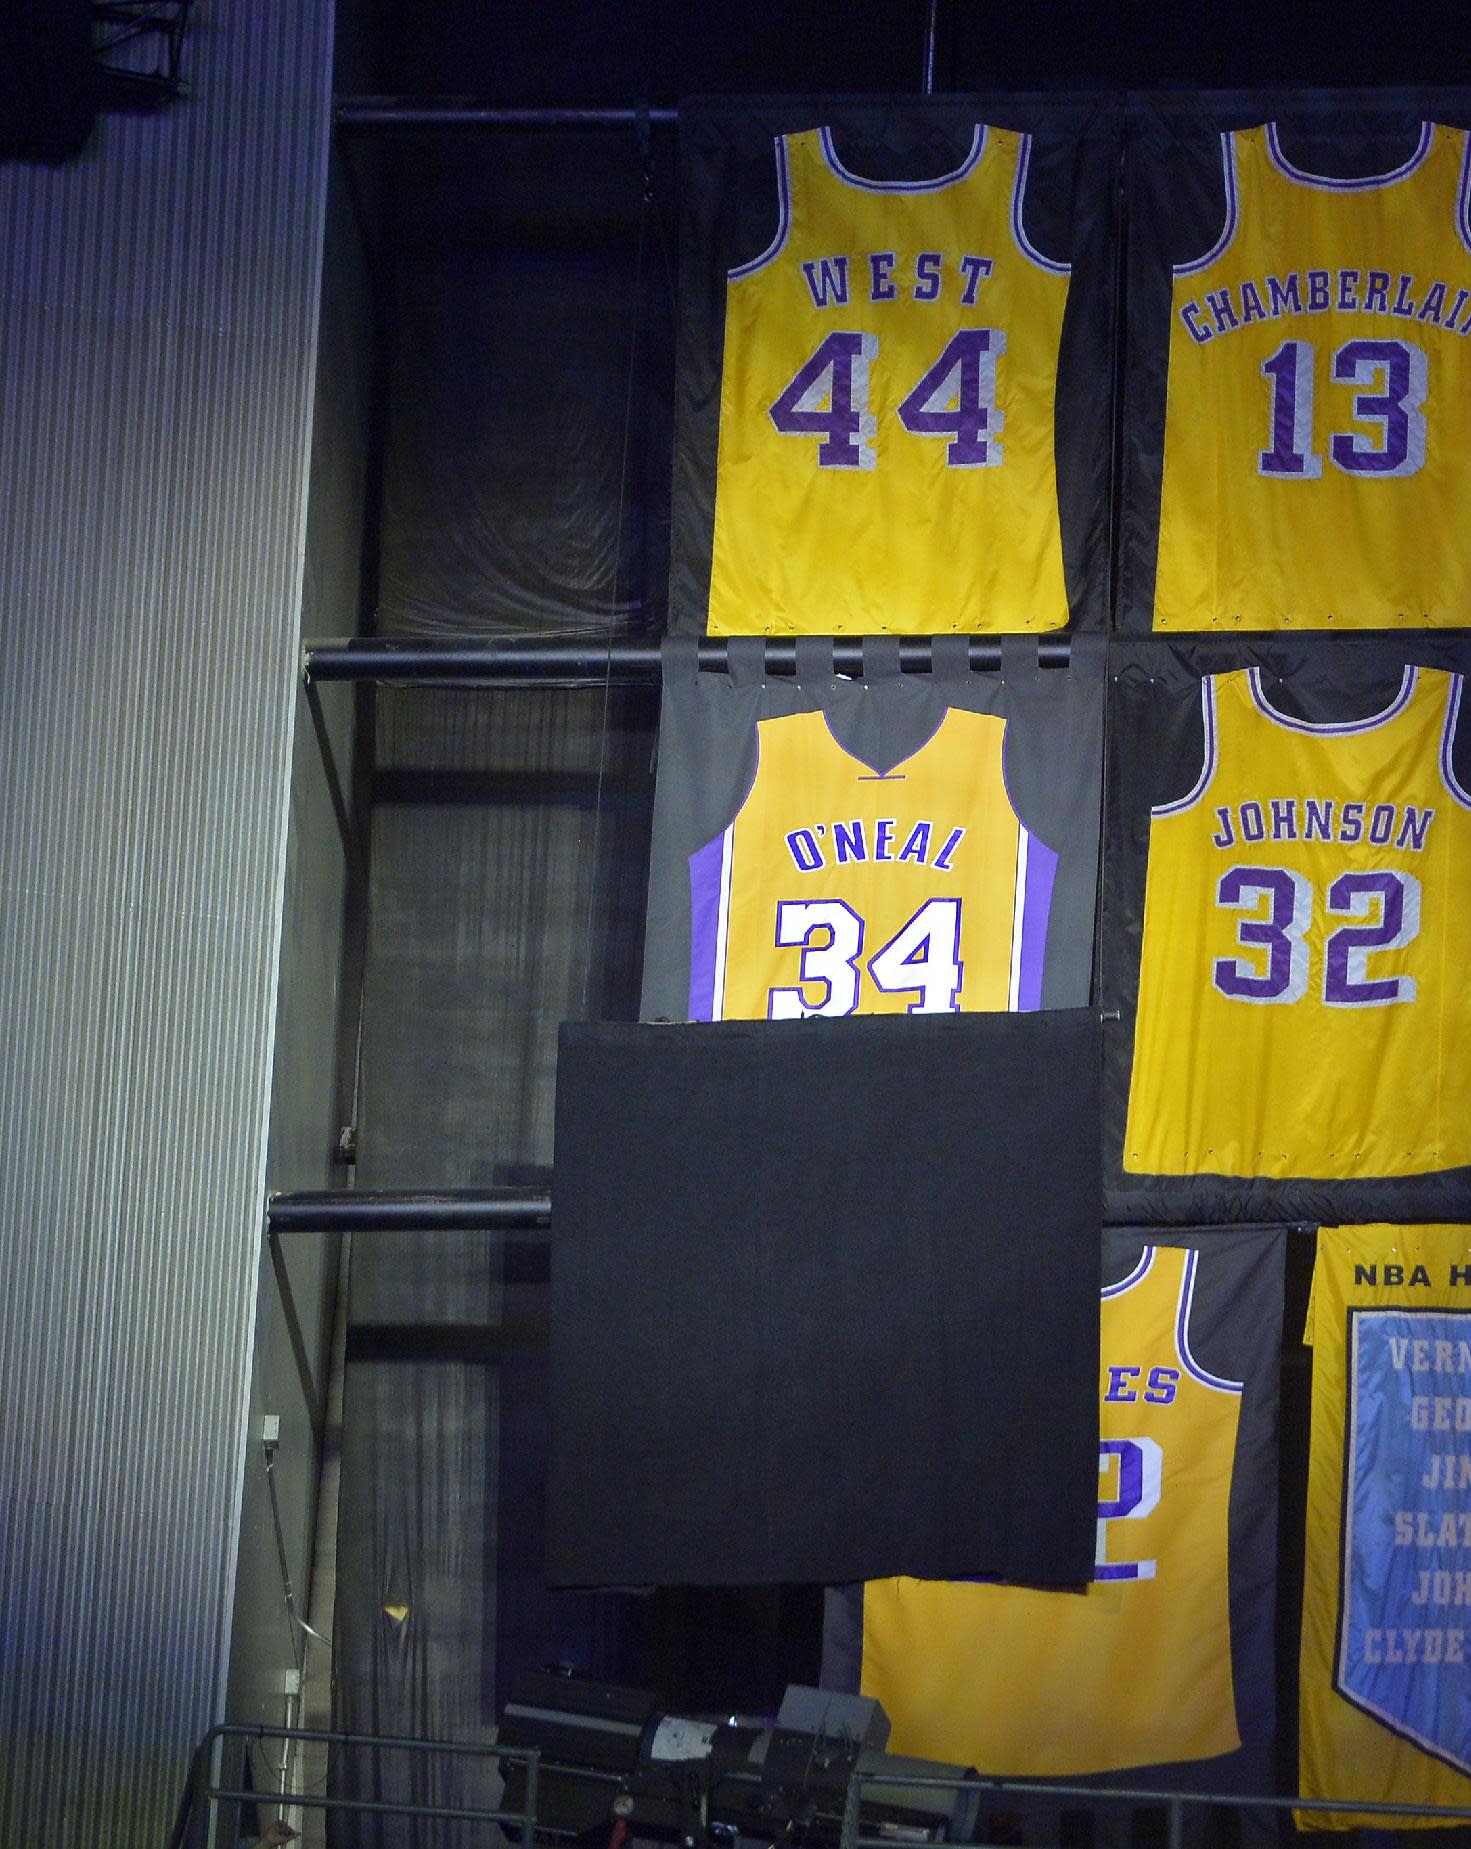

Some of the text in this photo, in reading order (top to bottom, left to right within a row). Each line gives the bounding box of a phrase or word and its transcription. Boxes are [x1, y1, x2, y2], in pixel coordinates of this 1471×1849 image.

[801, 251, 994, 308] WEST
[768, 327, 1006, 471] 44
[1257, 338, 1429, 478] 13
[784, 817, 966, 872] O'NEAL
[1213, 799, 1435, 852] JOHNSON
[767, 897, 964, 1020] 34
[1212, 864, 1422, 1009] 32
[1354, 1263, 1432, 1287] NBA
[1364, 1628, 1466, 1665] CLYDE
